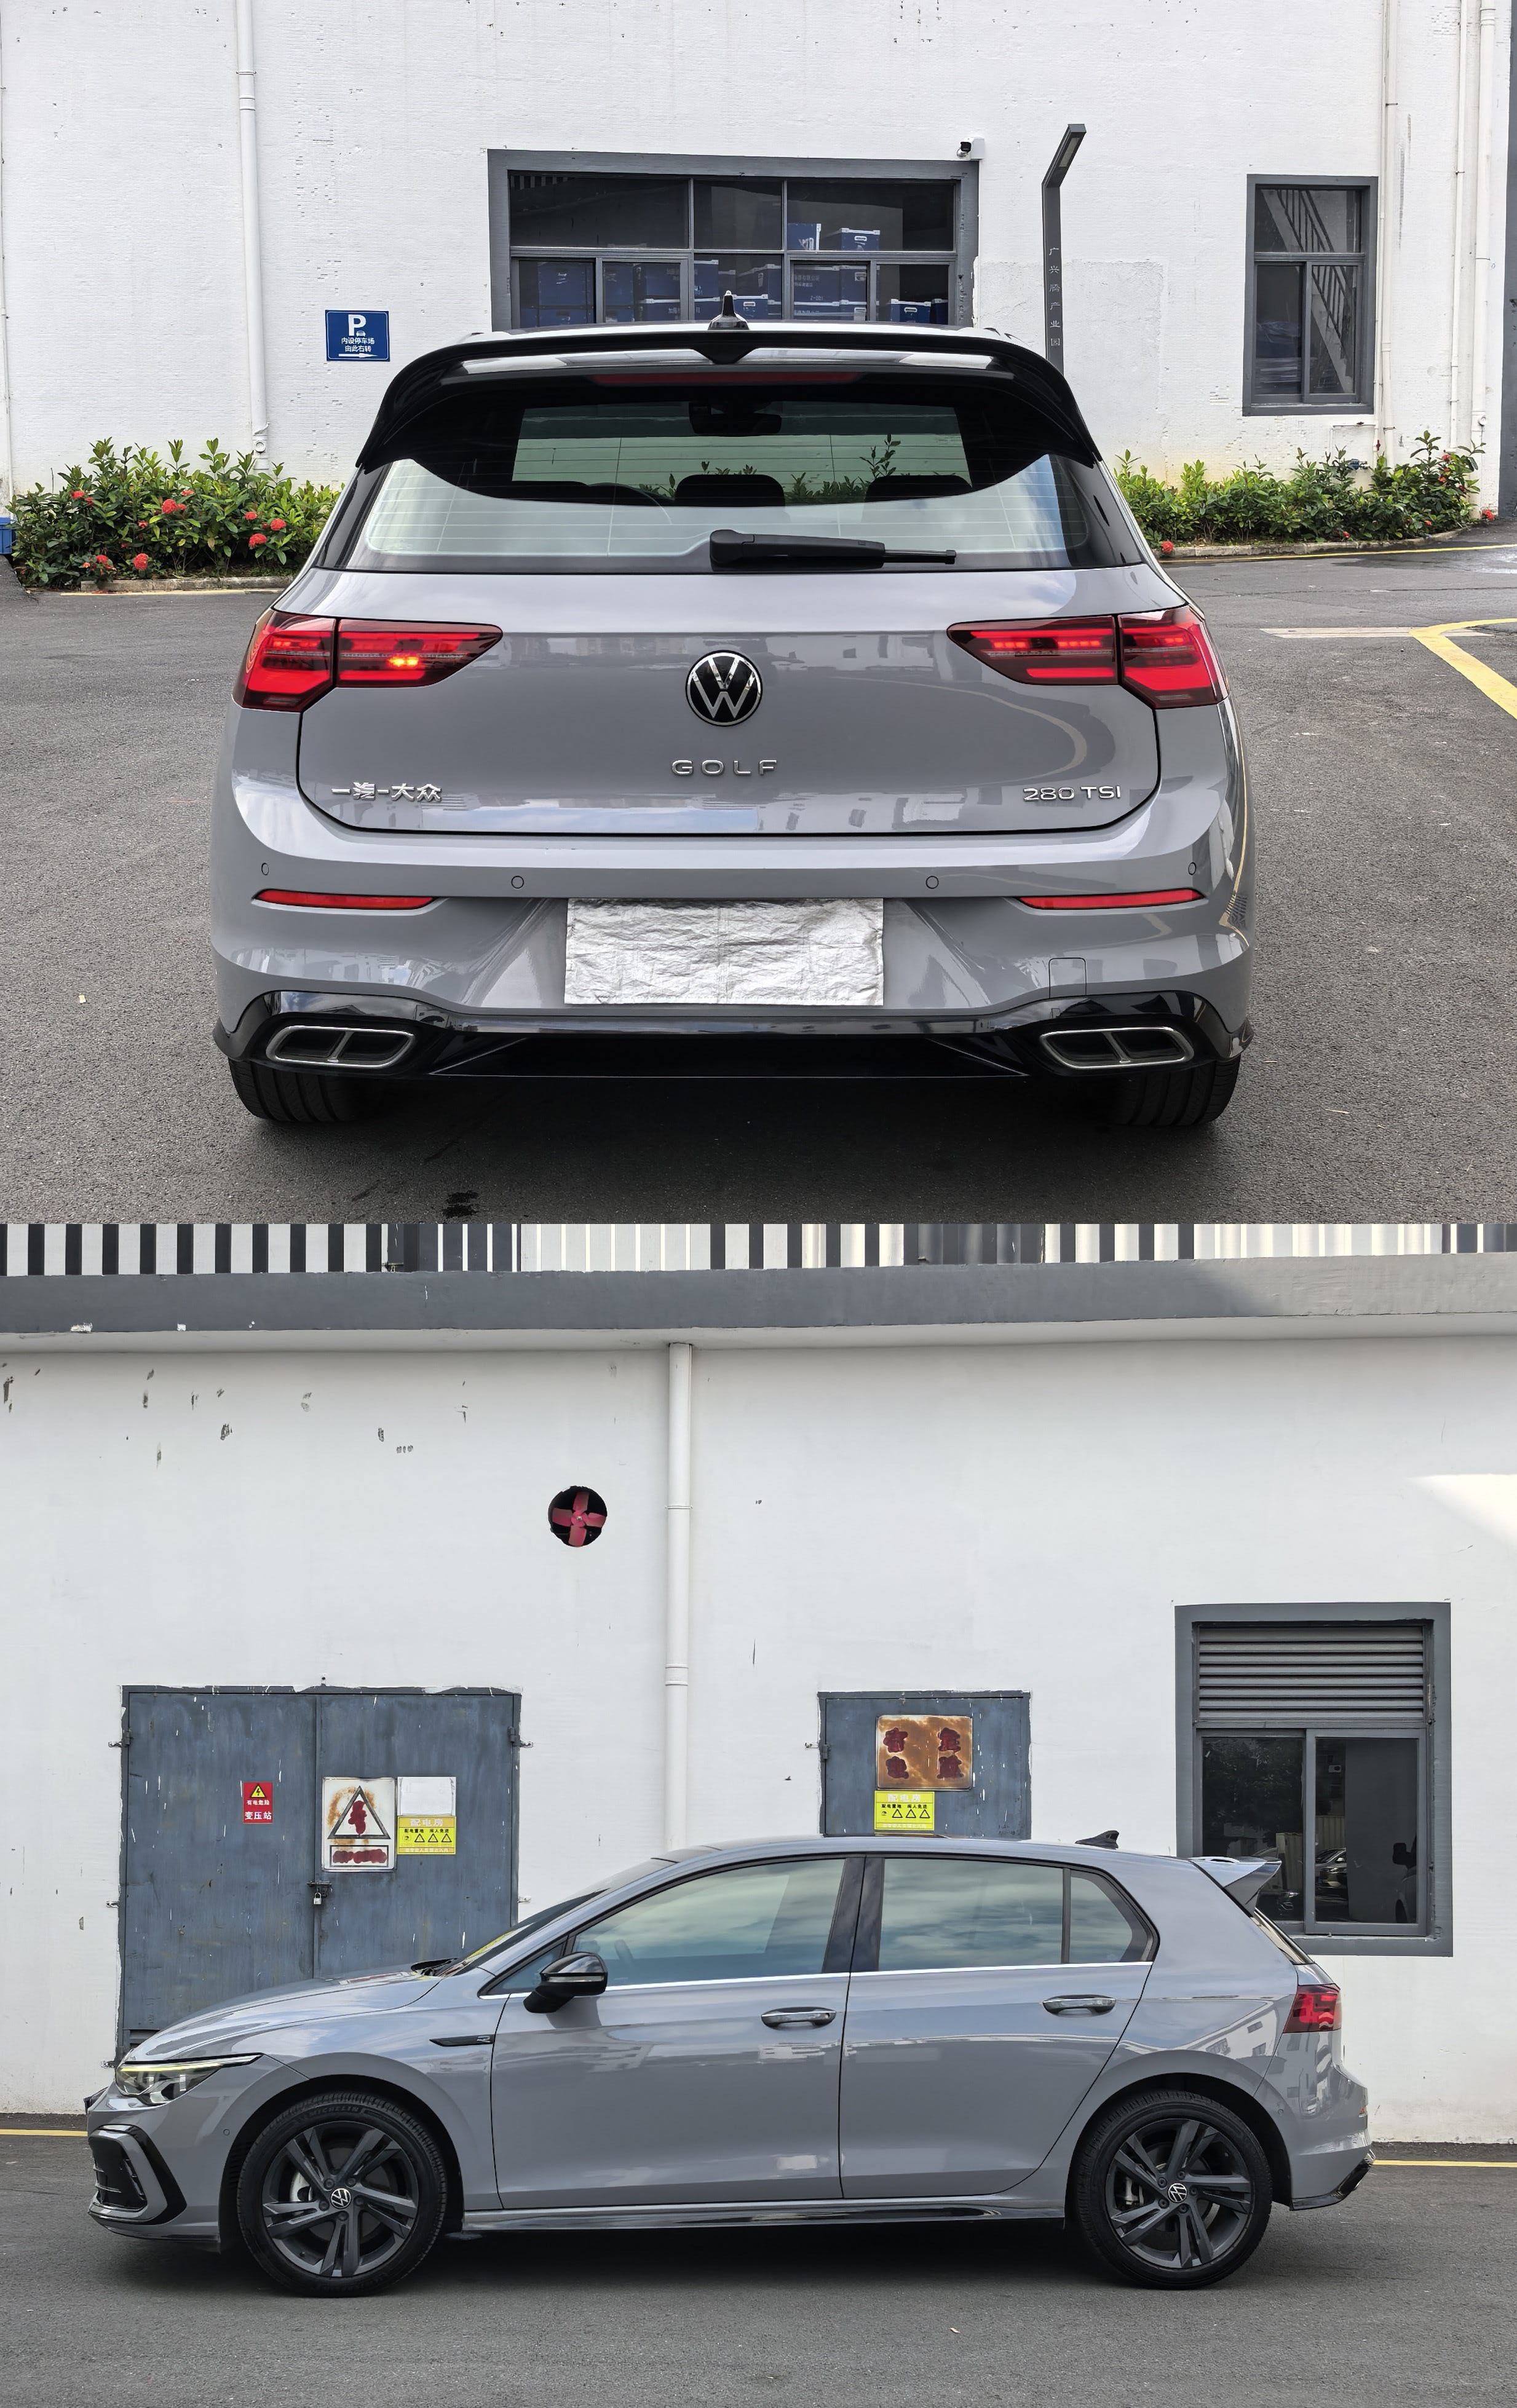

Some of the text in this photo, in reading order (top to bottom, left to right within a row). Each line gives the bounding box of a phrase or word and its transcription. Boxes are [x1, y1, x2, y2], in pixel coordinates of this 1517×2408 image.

[348, 314, 366, 336] P
[672, 760, 777, 775] GOLF
[331, 782, 442, 802] 一汽-大众
[1023, 785, 1122, 801] 280 TSI
[245, 1811, 272, 1820] 变压站
